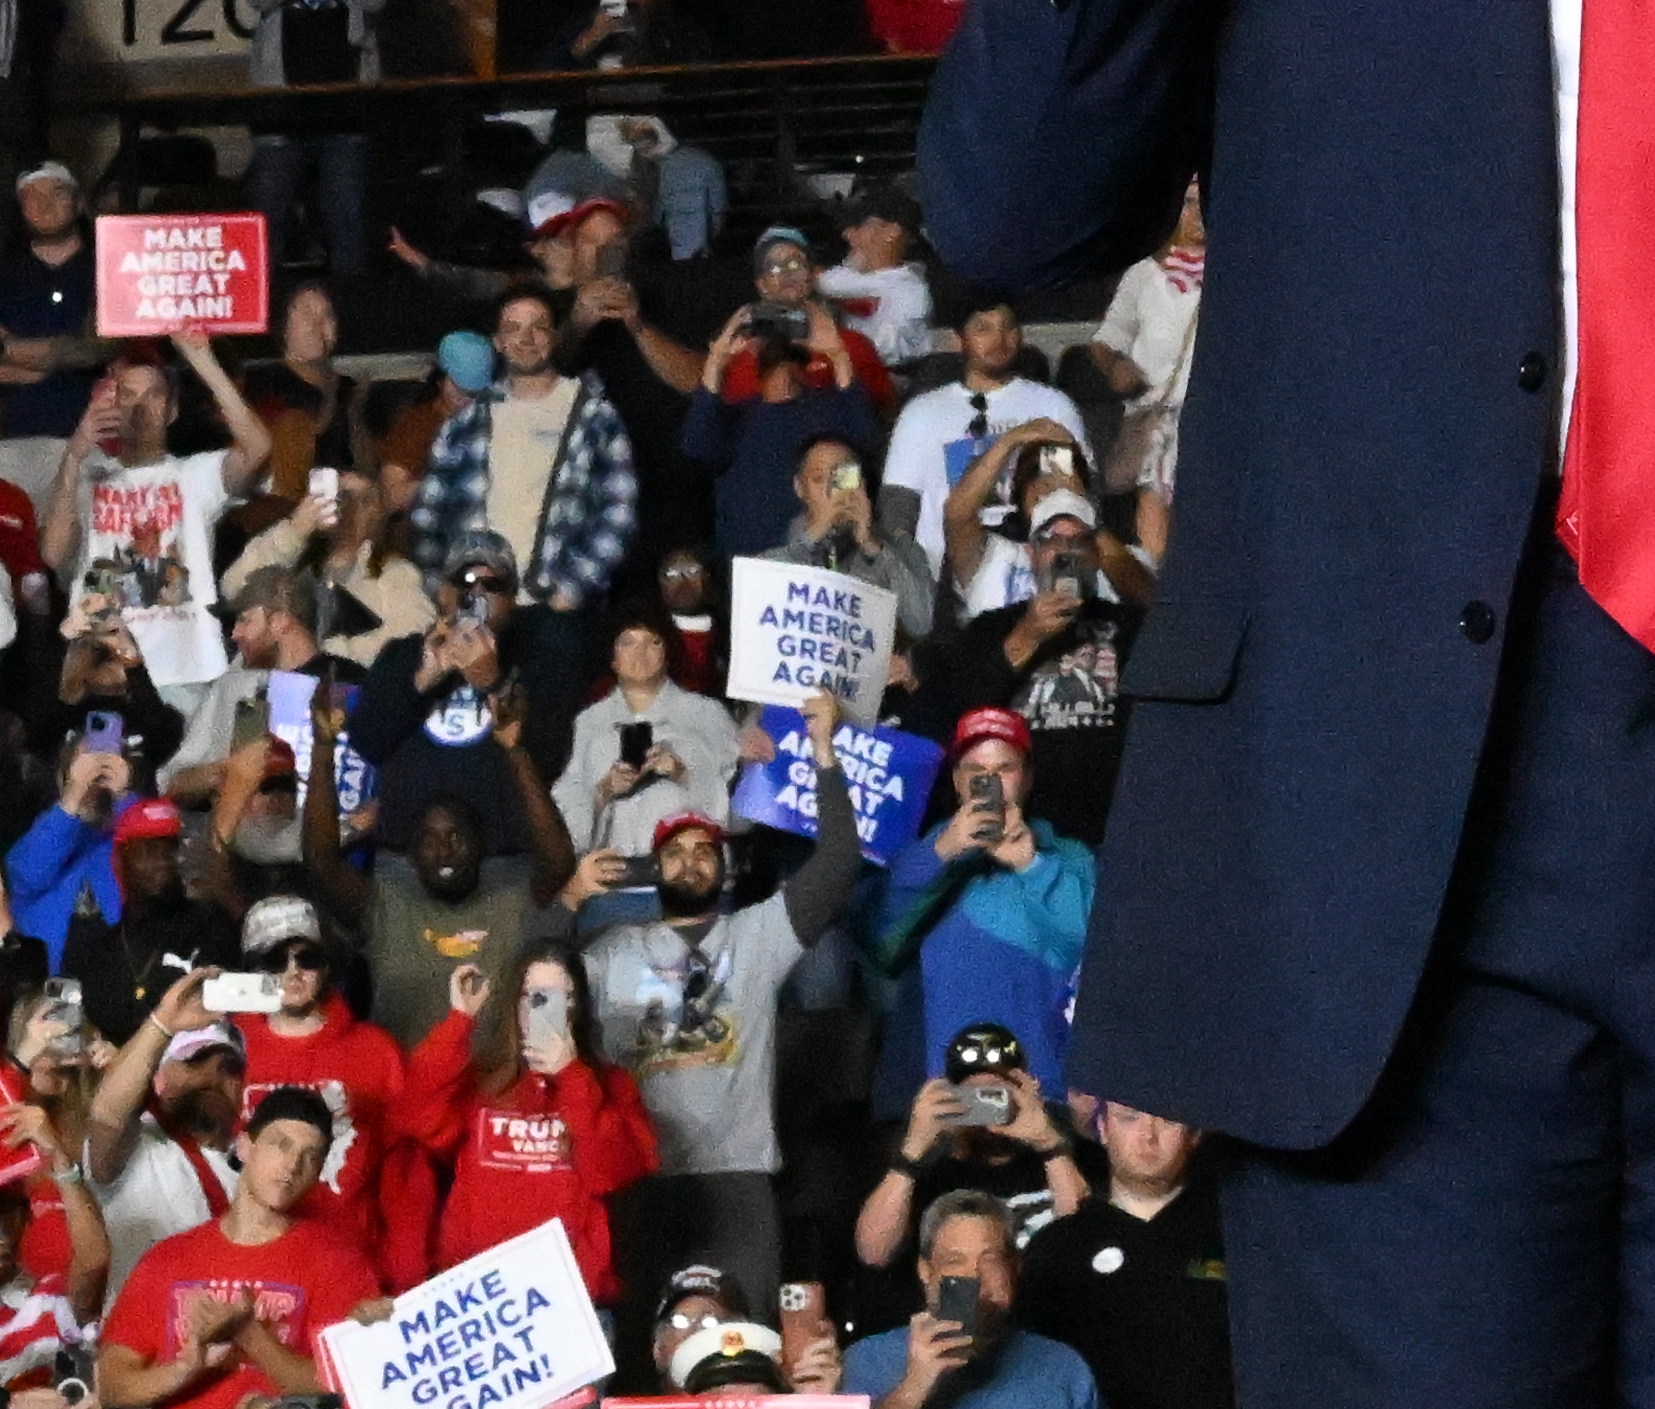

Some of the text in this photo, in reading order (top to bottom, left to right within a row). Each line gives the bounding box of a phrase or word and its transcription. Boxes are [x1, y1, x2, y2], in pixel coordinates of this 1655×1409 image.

[145, 226, 223, 248] MAKE
[120, 251, 246, 272] AMERICA
[137, 273, 231, 296] GREAT
[135, 295, 234, 318] AGAIN!
[788, 582, 862, 618] MAKE
[759, 606, 875, 652] AMERICA
[777, 635, 861, 674] GREAT
[832, 725, 894, 767] AKE
[399, 1269, 506, 1344] MAKE
[382, 1287, 550, 1390] AMERICA
[411, 1325, 534, 1405] GREAT
